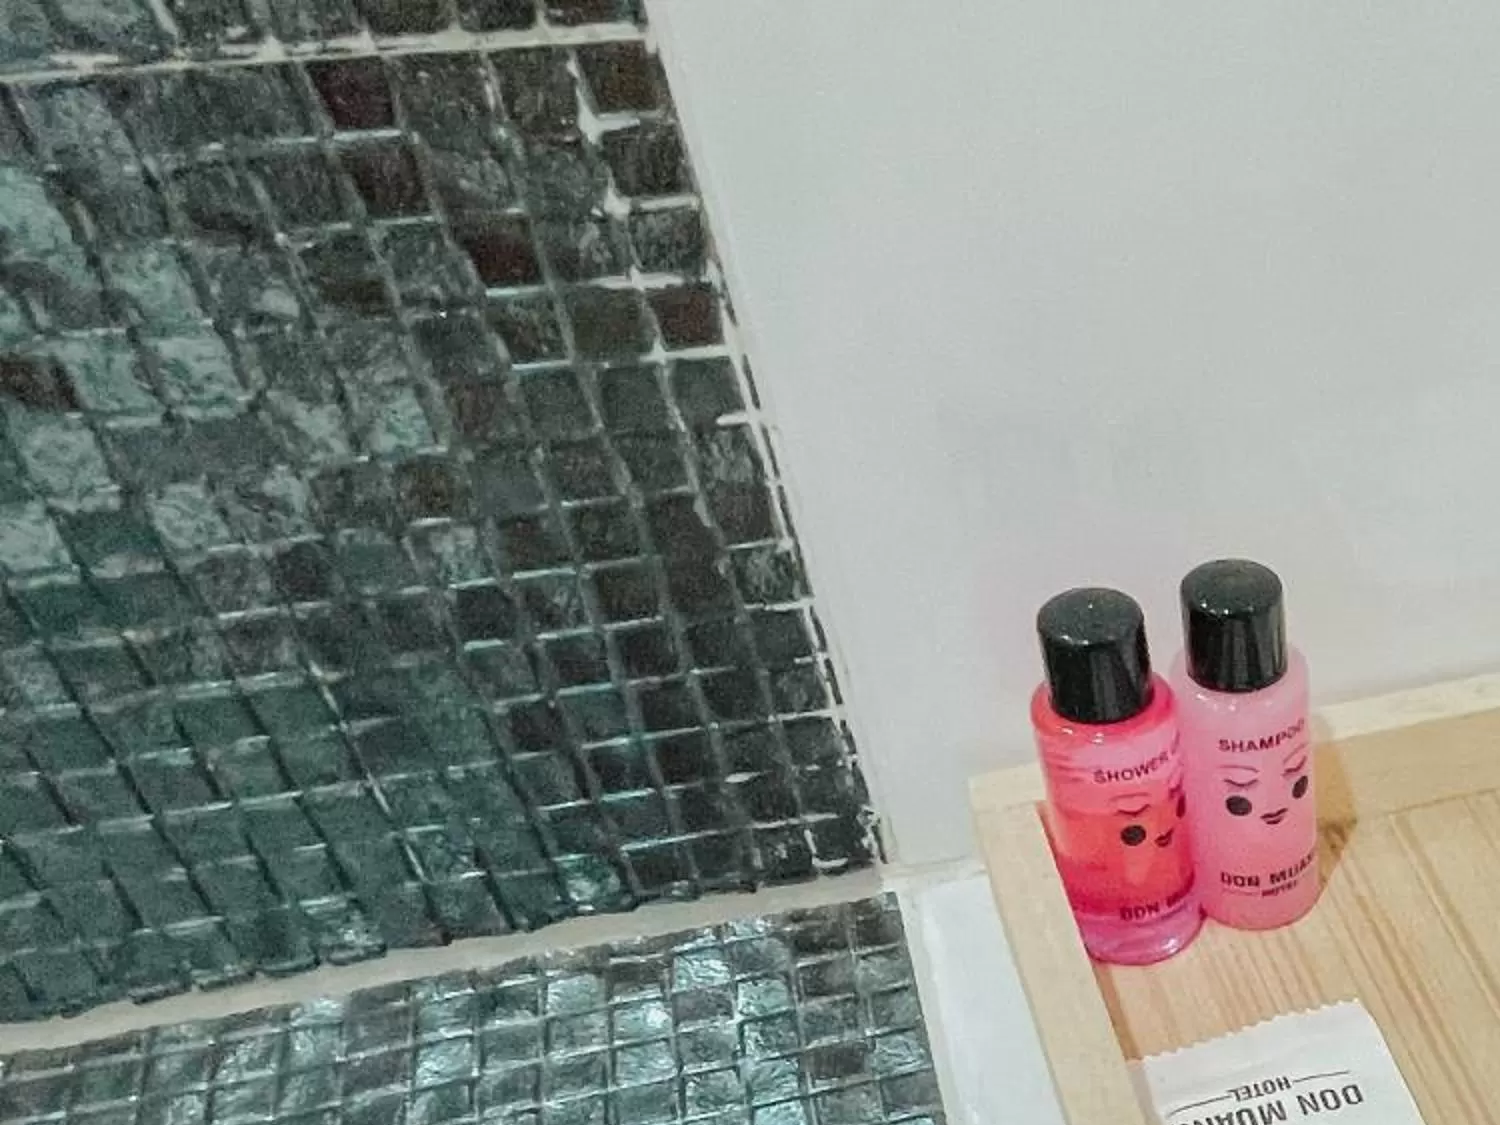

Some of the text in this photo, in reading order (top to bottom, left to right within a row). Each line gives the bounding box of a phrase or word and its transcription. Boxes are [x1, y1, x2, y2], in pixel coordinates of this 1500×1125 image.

[1094, 750, 1169, 785] SHOWER
[1220, 871, 1260, 888] DON
[1120, 901, 1160, 921] DON
[1227, 1075, 1293, 1103] HOTEL
[1295, 1083, 1365, 1116] DON
